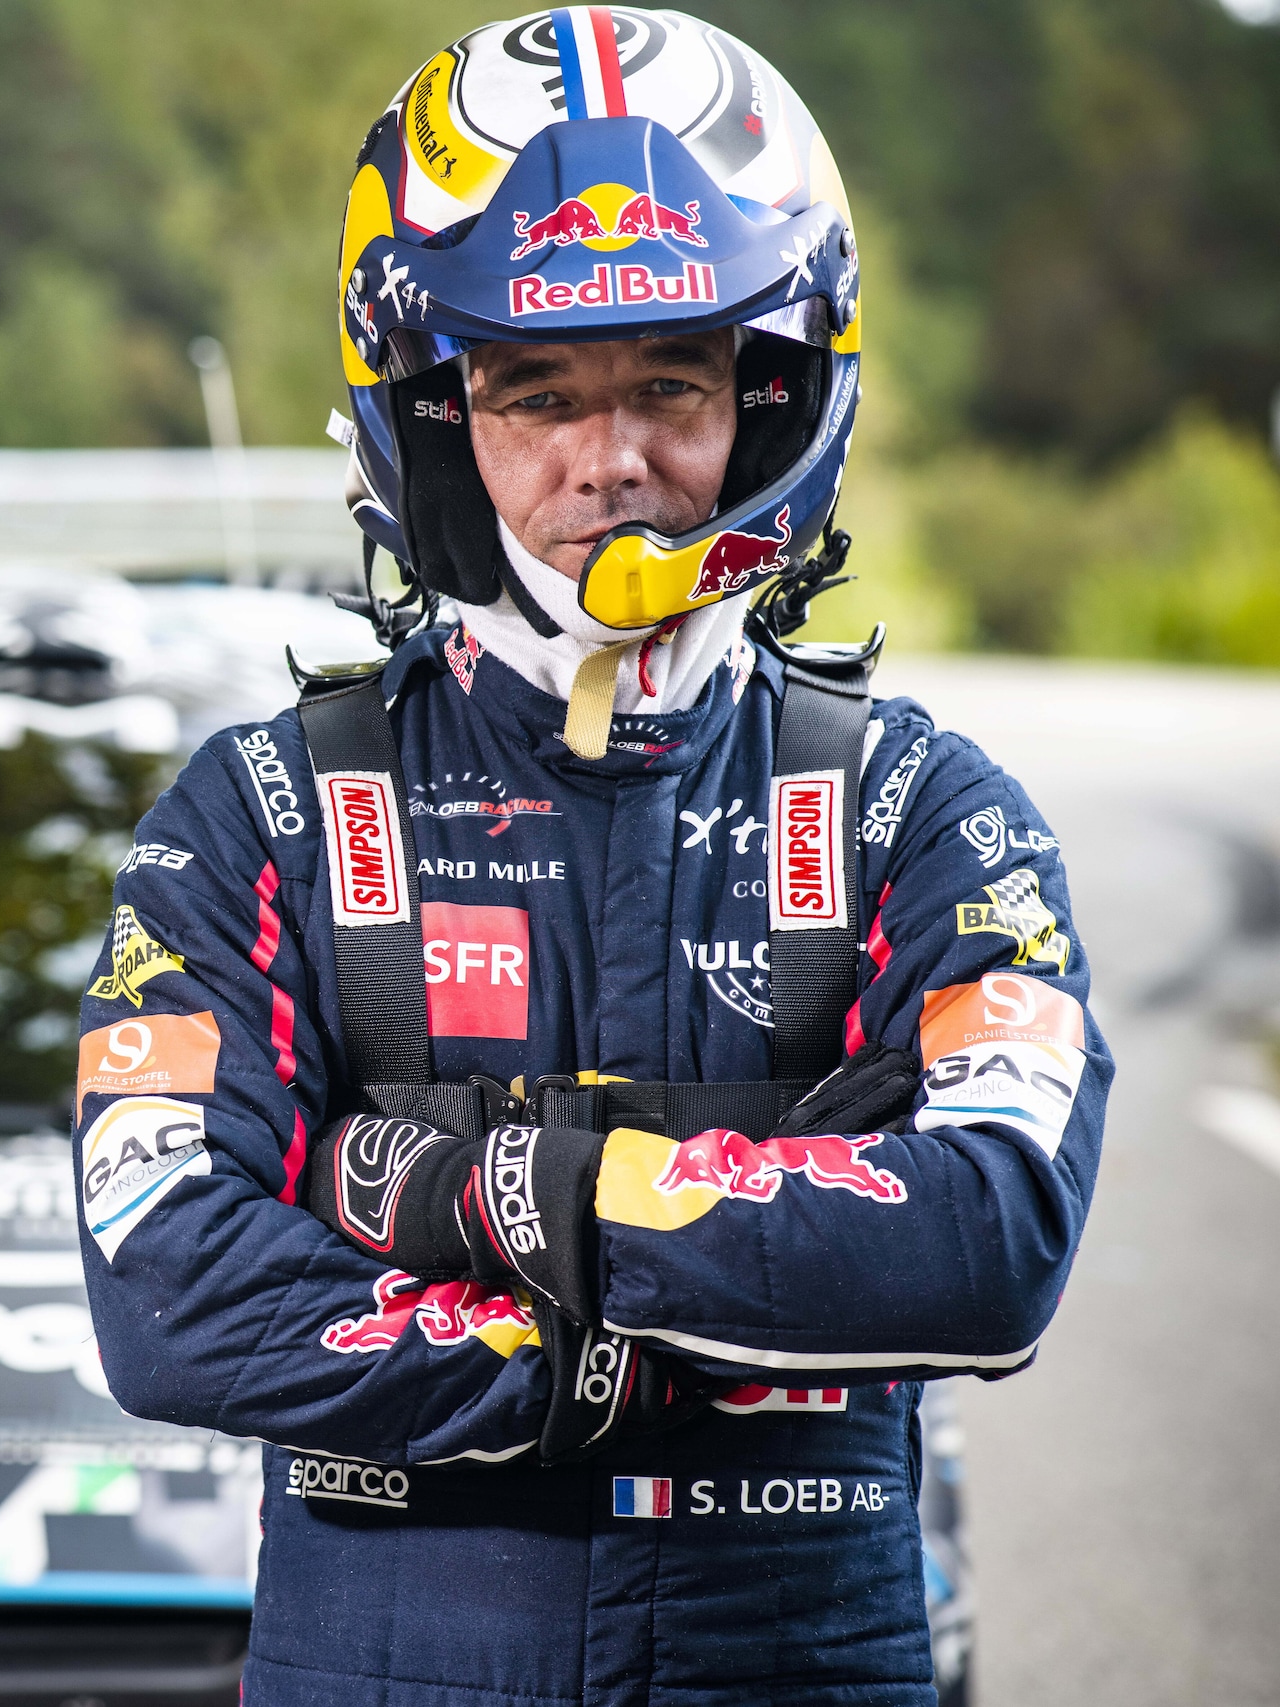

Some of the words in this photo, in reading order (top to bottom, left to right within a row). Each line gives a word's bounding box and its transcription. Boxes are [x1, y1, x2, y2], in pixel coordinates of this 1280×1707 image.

[415, 67, 449, 166] Continental
[511, 265, 611, 315] Red
[617, 263, 717, 304] Bull
[452, 653, 474, 695] Bull
[236, 730, 305, 836] sparco
[409, 797, 553, 817] ENLOEBRACING
[340, 786, 387, 907] SIMPSON
[417, 857, 477, 880] ARD
[488, 860, 566, 883] MILLE
[788, 790, 824, 910] SIMPSON
[423, 939, 525, 987] SFR
[84, 1122, 202, 1204] GAC
[495, 1124, 541, 1254] sparc
[287, 1458, 410, 1500] sparco
[690, 1480, 726, 1514] S.
[740, 1478, 843, 1514] LOEB
